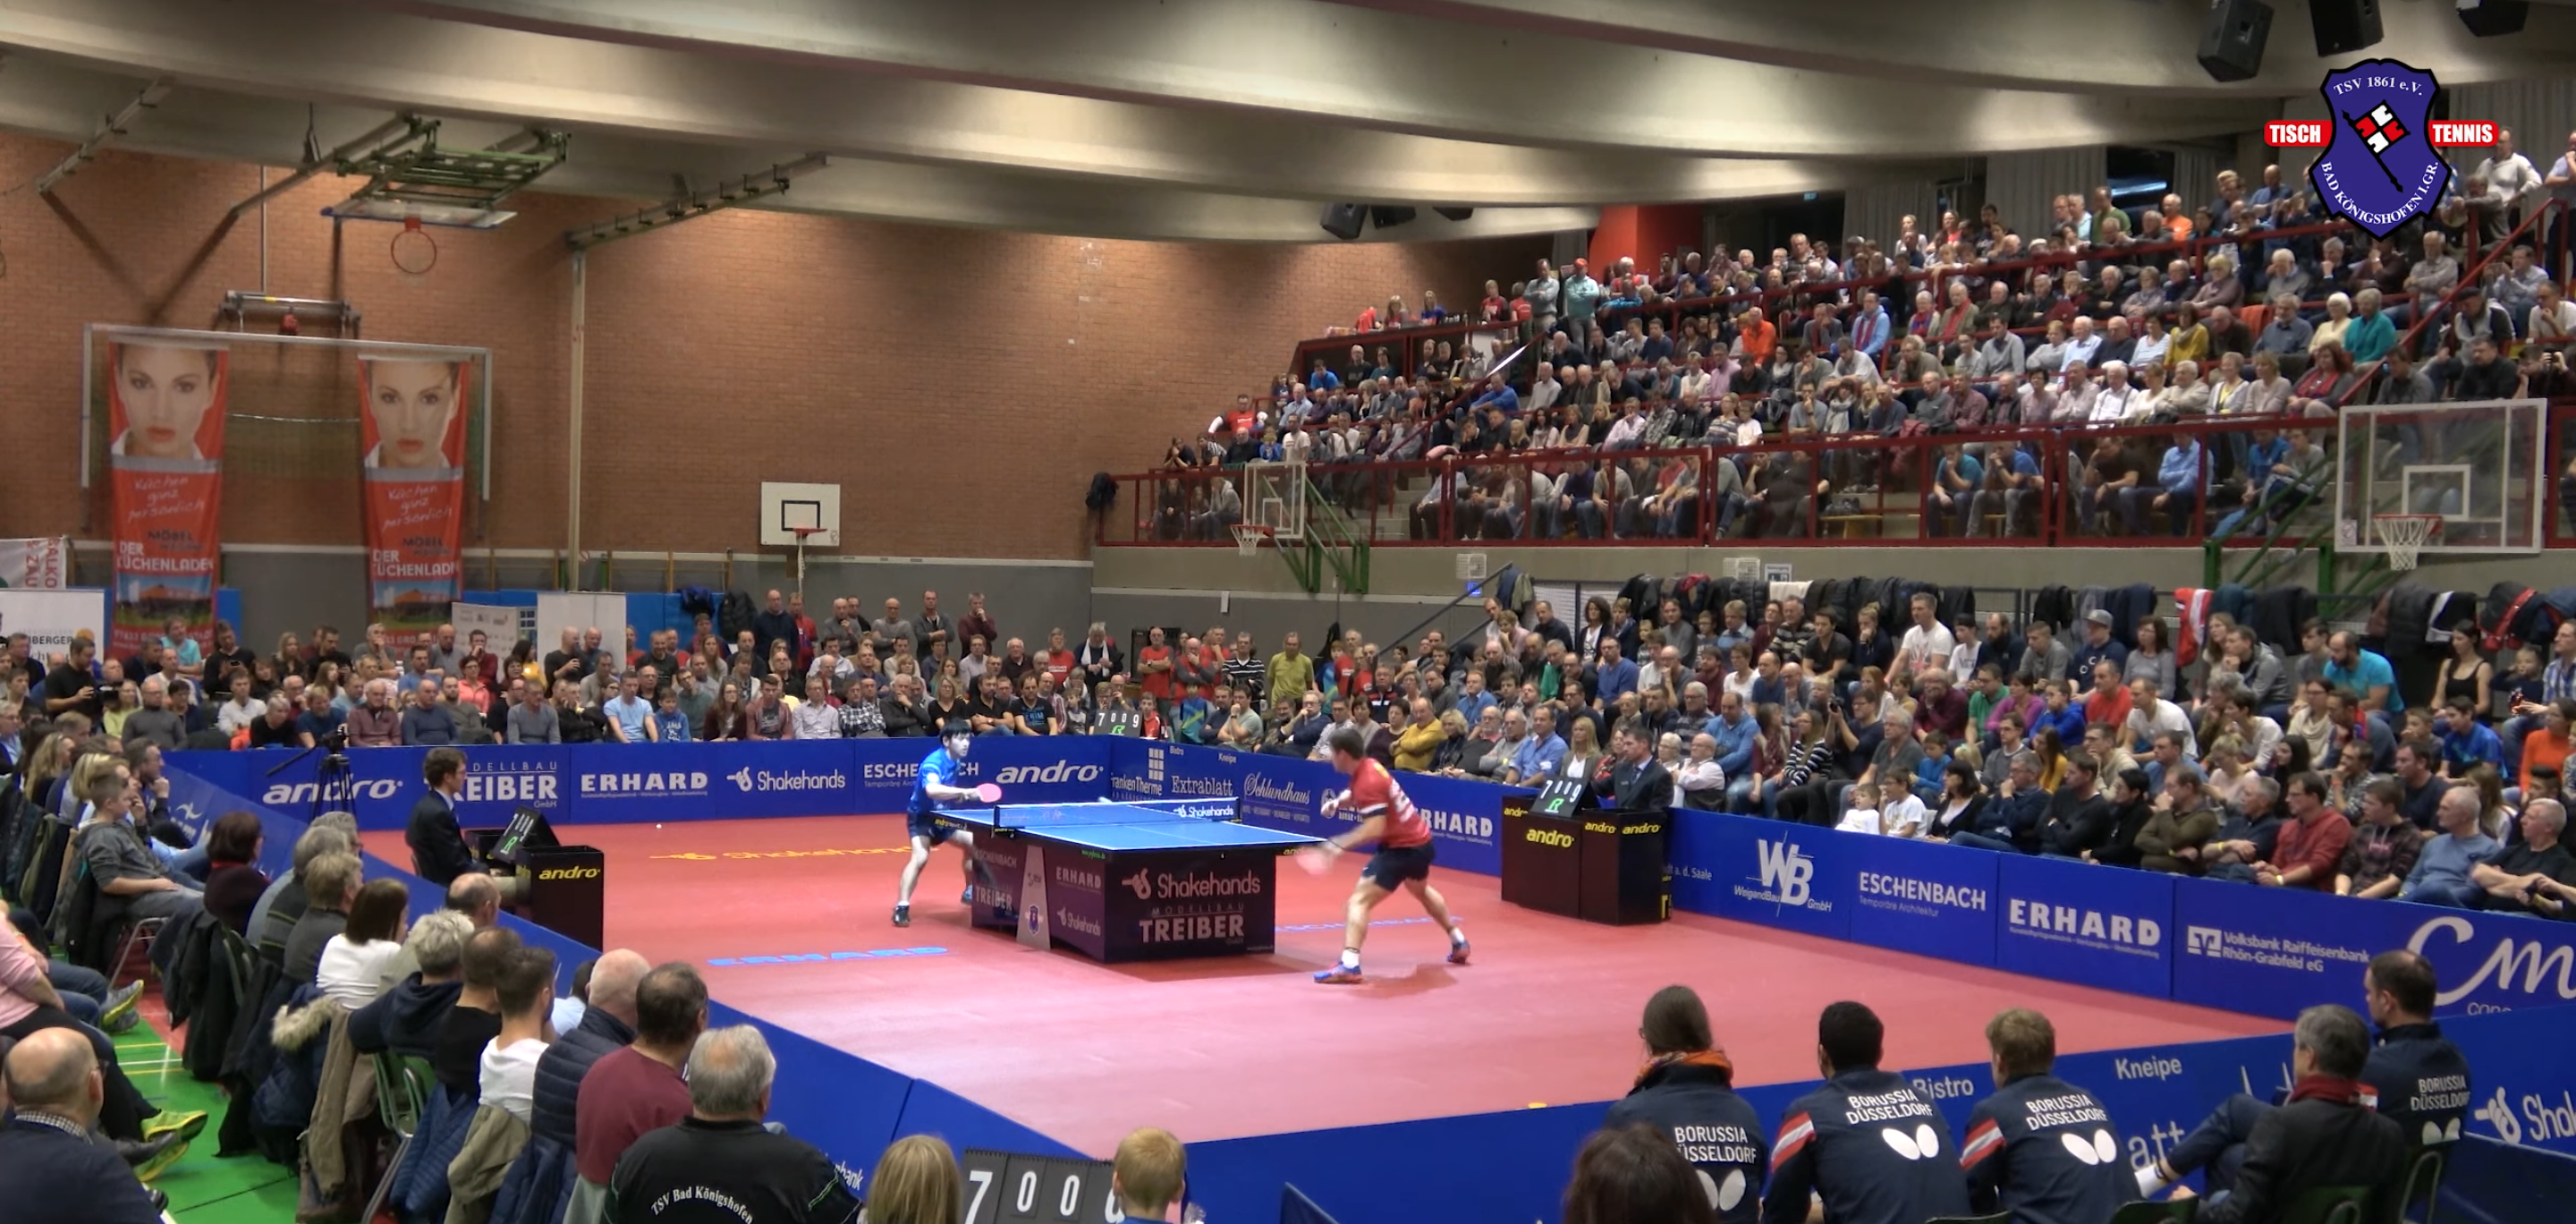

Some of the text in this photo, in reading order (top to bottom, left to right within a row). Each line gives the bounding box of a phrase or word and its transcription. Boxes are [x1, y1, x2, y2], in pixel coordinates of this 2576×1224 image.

[119, 540, 144, 557] DER
[372, 549, 400, 563] DER
[30, 635, 73, 645] BERGER
[1097, 712, 1106, 727] 7
[1132, 714, 1140, 728] 9
[471, 761, 558, 772] DELLBAU
[1218, 752, 1237, 764] Kneipe
[757, 769, 846, 792] Shakehands
[863, 762, 979, 778] ESCHECH
[996, 760, 1099, 784] andro
[580, 771, 708, 792] ERHARD
[1171, 775, 1233, 796] Extrablatt
[1243, 771, 1310, 805] Schlundhaus
[1539, 779, 1555, 799] 7
[1569, 784, 1582, 803] 9
[1188, 805, 1234, 818] Shakehands
[1419, 808, 1493, 837] RHARD
[1584, 820, 1615, 834] andro
[1622, 821, 1660, 835] andro
[1526, 827, 1573, 848] andro
[538, 865, 598, 880] andro
[1055, 866, 1102, 889] ERHARD
[1157, 869, 1261, 899] Shakehands
[1859, 871, 1987, 912] ESCHENBACH
[975, 885, 1013, 912] TREIBER
[1151, 902, 1245, 916] MODELLBAU
[1807, 898, 1833, 913] GmbH
[1139, 914, 1245, 943] TREIBER
[2009, 897, 2162, 947] ERHARD
[2224, 931, 2370, 964] Volksbank Raiffeisenbank
[2222, 945, 2324, 973] Rhön-Grabfeld eG
[2114, 1055, 2183, 1082] Kneipe
[2419, 1075, 2468, 1093] BORUSSIA
[1847, 1088, 1919, 1109] BORUSSIA
[2025, 1093, 2095, 1114] BORUSSIA
[1845, 1102, 1934, 1125] DÜSSELDORF
[2026, 1107, 2109, 1131] DÜSSELDORF
[1674, 1126, 1749, 1144] BORUSSIA
[1676, 1144, 1758, 1165] ÜSSELDORF
[650, 1185, 754, 1224] TSV Bad Königshofen
[964, 1170, 994, 1224] 7
